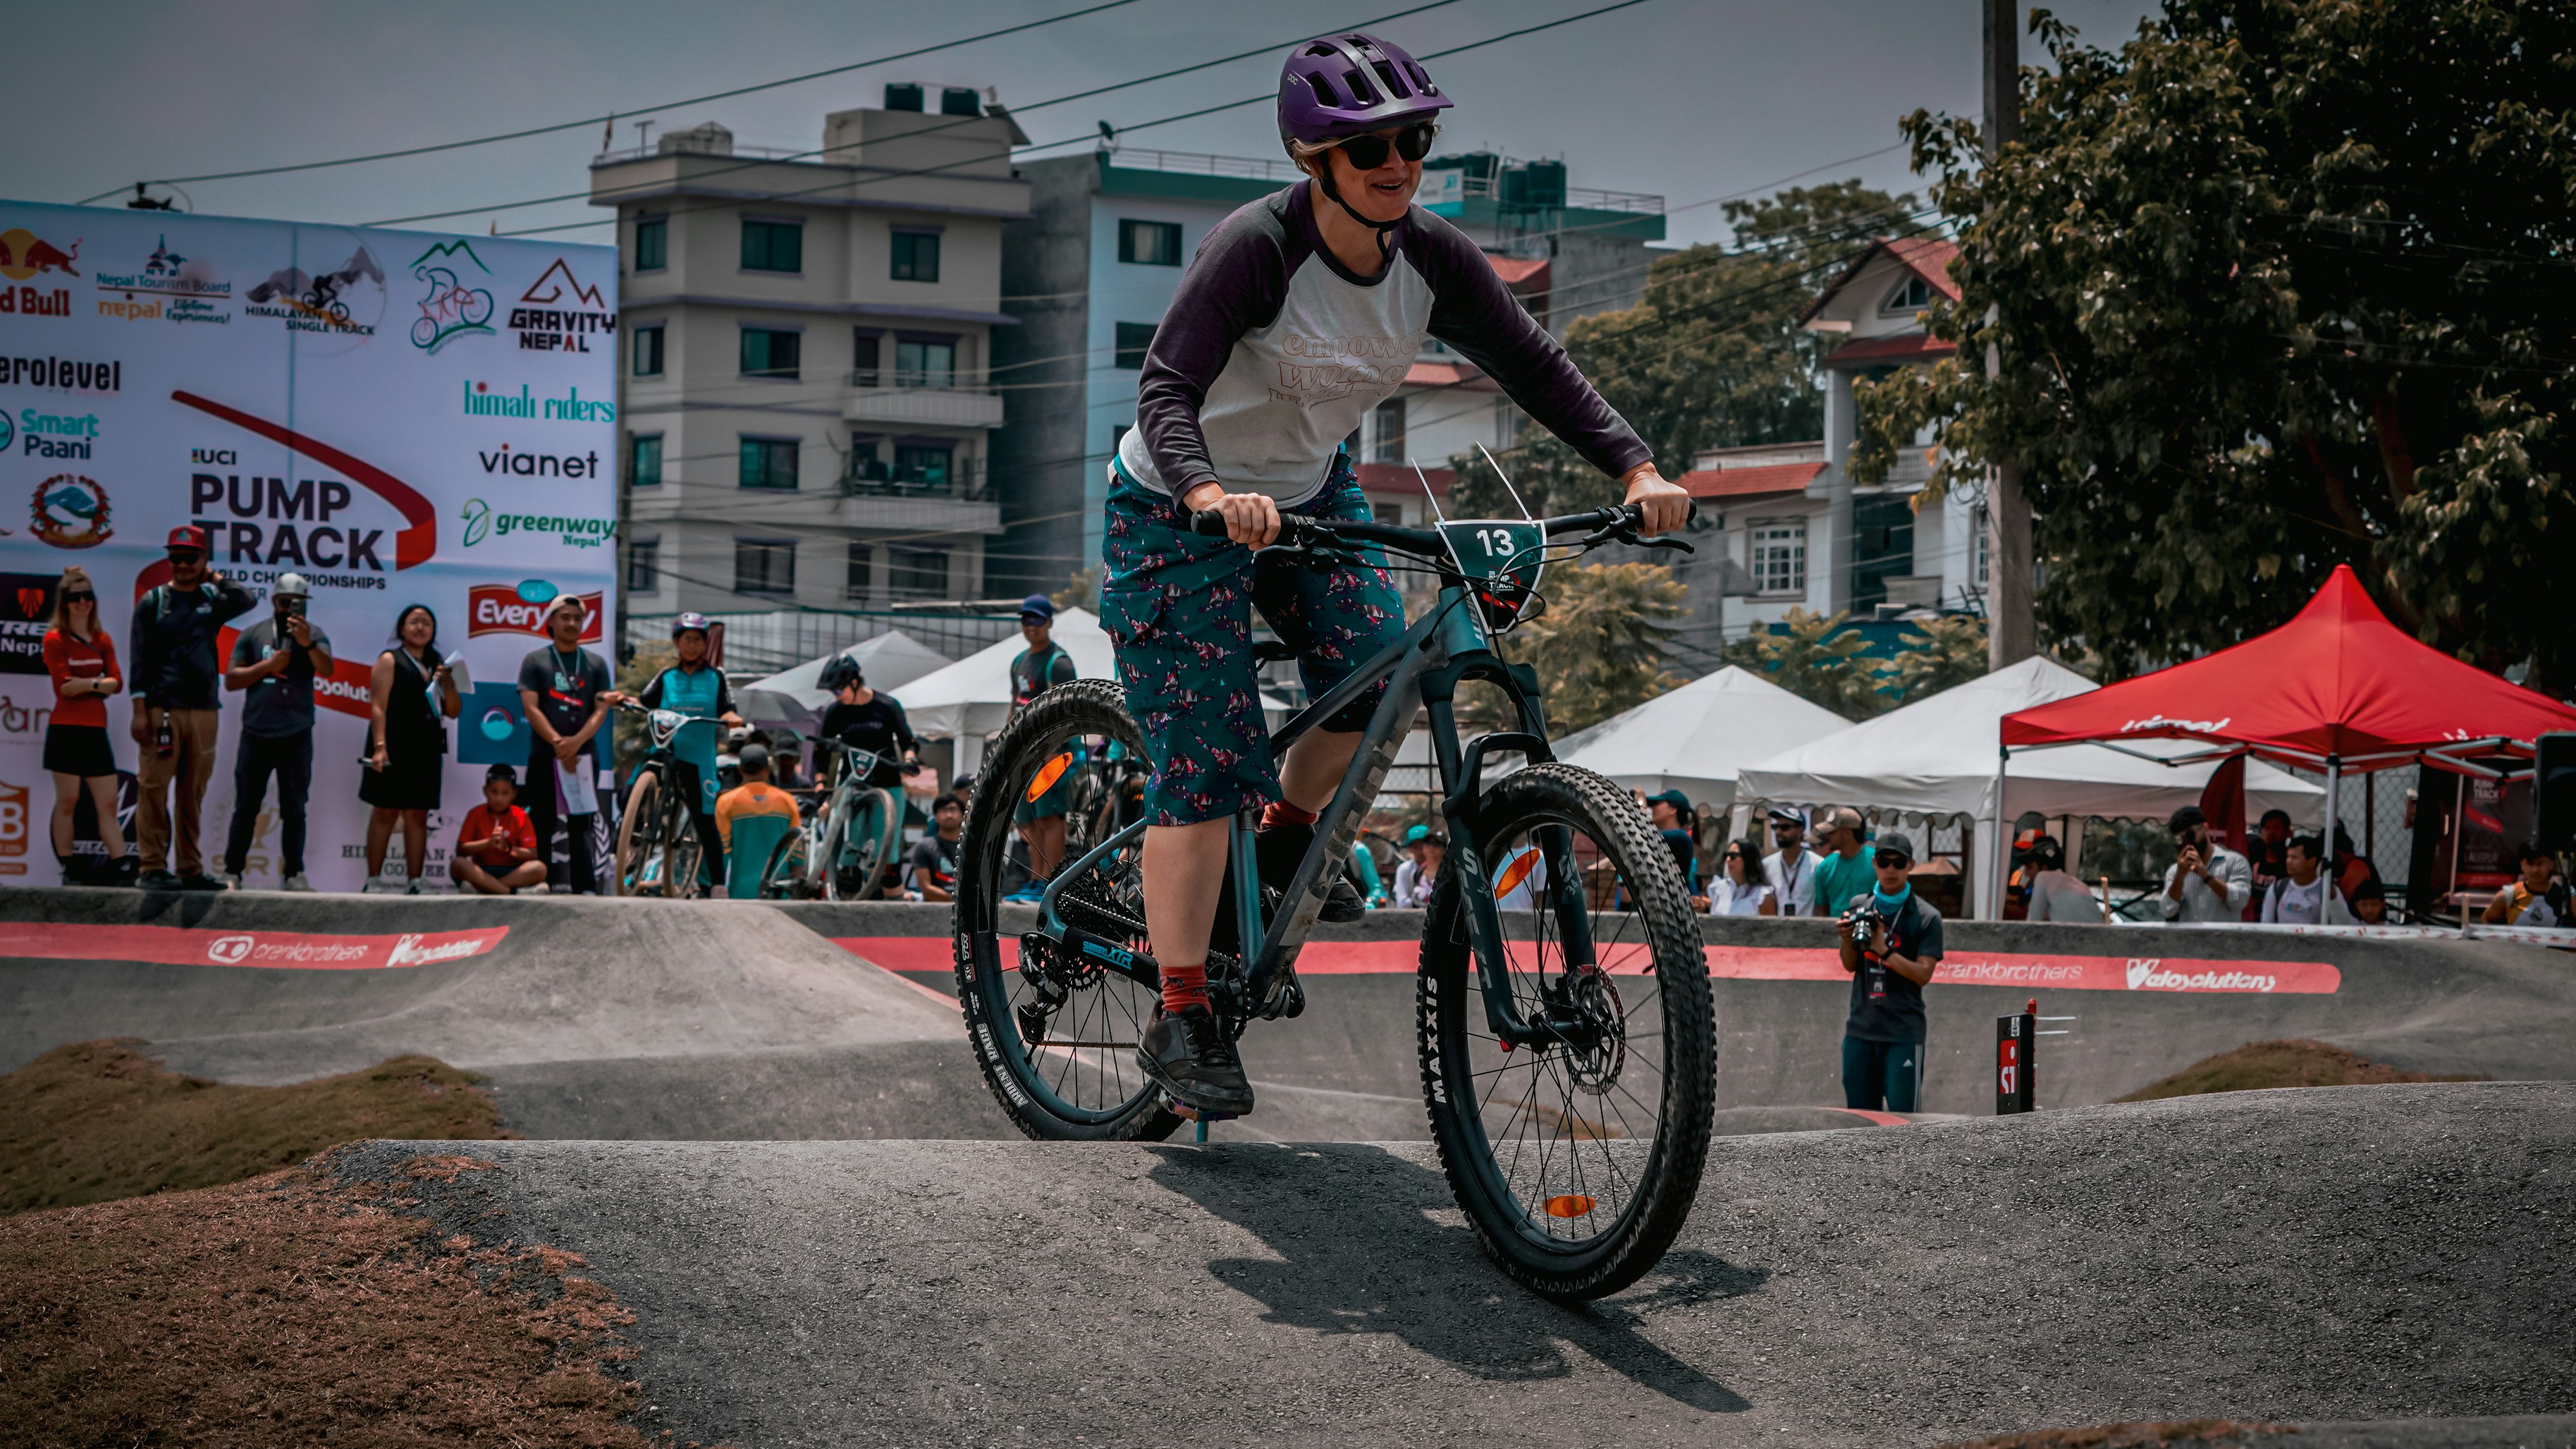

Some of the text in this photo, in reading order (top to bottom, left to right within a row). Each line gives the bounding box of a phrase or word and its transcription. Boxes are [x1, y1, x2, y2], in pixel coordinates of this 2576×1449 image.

[97, 273, 231, 293] Nepal Tourism Board
[21, 288, 70, 317] Bull
[98, 300, 161, 321] nepal
[173, 298, 214, 312] Lifetime
[245, 306, 322, 319] HIMALAYAN
[286, 320, 375, 336] SINGLE TRACK
[508, 308, 616, 334] GRAVITY
[520, 331, 590, 353] NEPAL
[0, 356, 121, 391] erolevel
[1277, 361, 1409, 391] wome
[464, 379, 616, 423] himali riders
[20, 408, 99, 437] Smart
[24, 435, 92, 460] Paani
[200, 449, 237, 465] UCI
[479, 443, 599, 478] vianet
[191, 473, 351, 522] PUMP
[496, 513, 617, 540] greenway
[191, 520, 385, 571] TRACK
[563, 534, 601, 548] Nepal
[1476, 529, 1516, 556] 13
[253, 570, 386, 590] CHPIONSHIPS
[1107, 946, 1134, 967] XTR
[1934, 960, 2085, 981] crankbrothers
[1425, 976, 1447, 1103] MAXXIS
[976, 1022, 1029, 1108] ARDENT RACE
